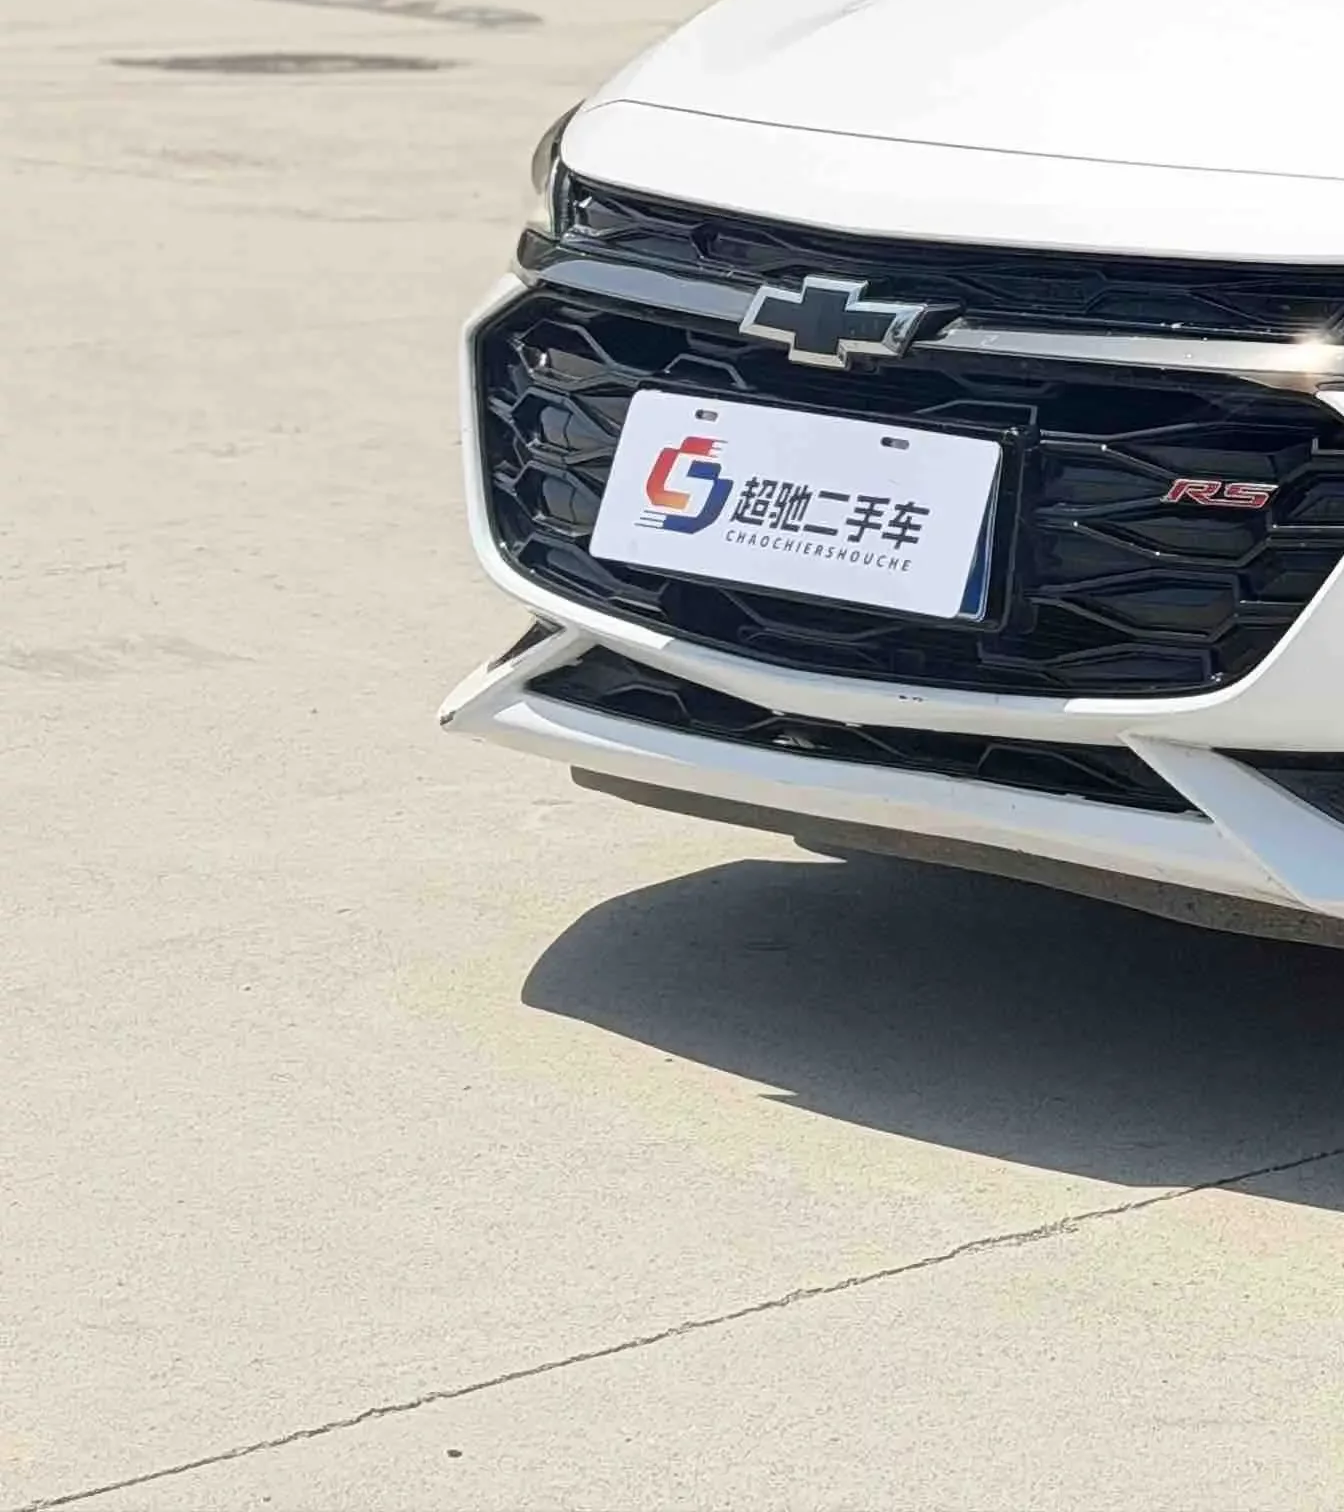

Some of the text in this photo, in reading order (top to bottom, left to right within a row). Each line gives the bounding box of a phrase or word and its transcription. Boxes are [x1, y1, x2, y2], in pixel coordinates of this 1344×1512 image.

[729, 476, 930, 550] 超驰二手车
[1161, 478, 1280, 509] RS
[725, 529, 913, 572] CHAOCHIERSHOUCHE
